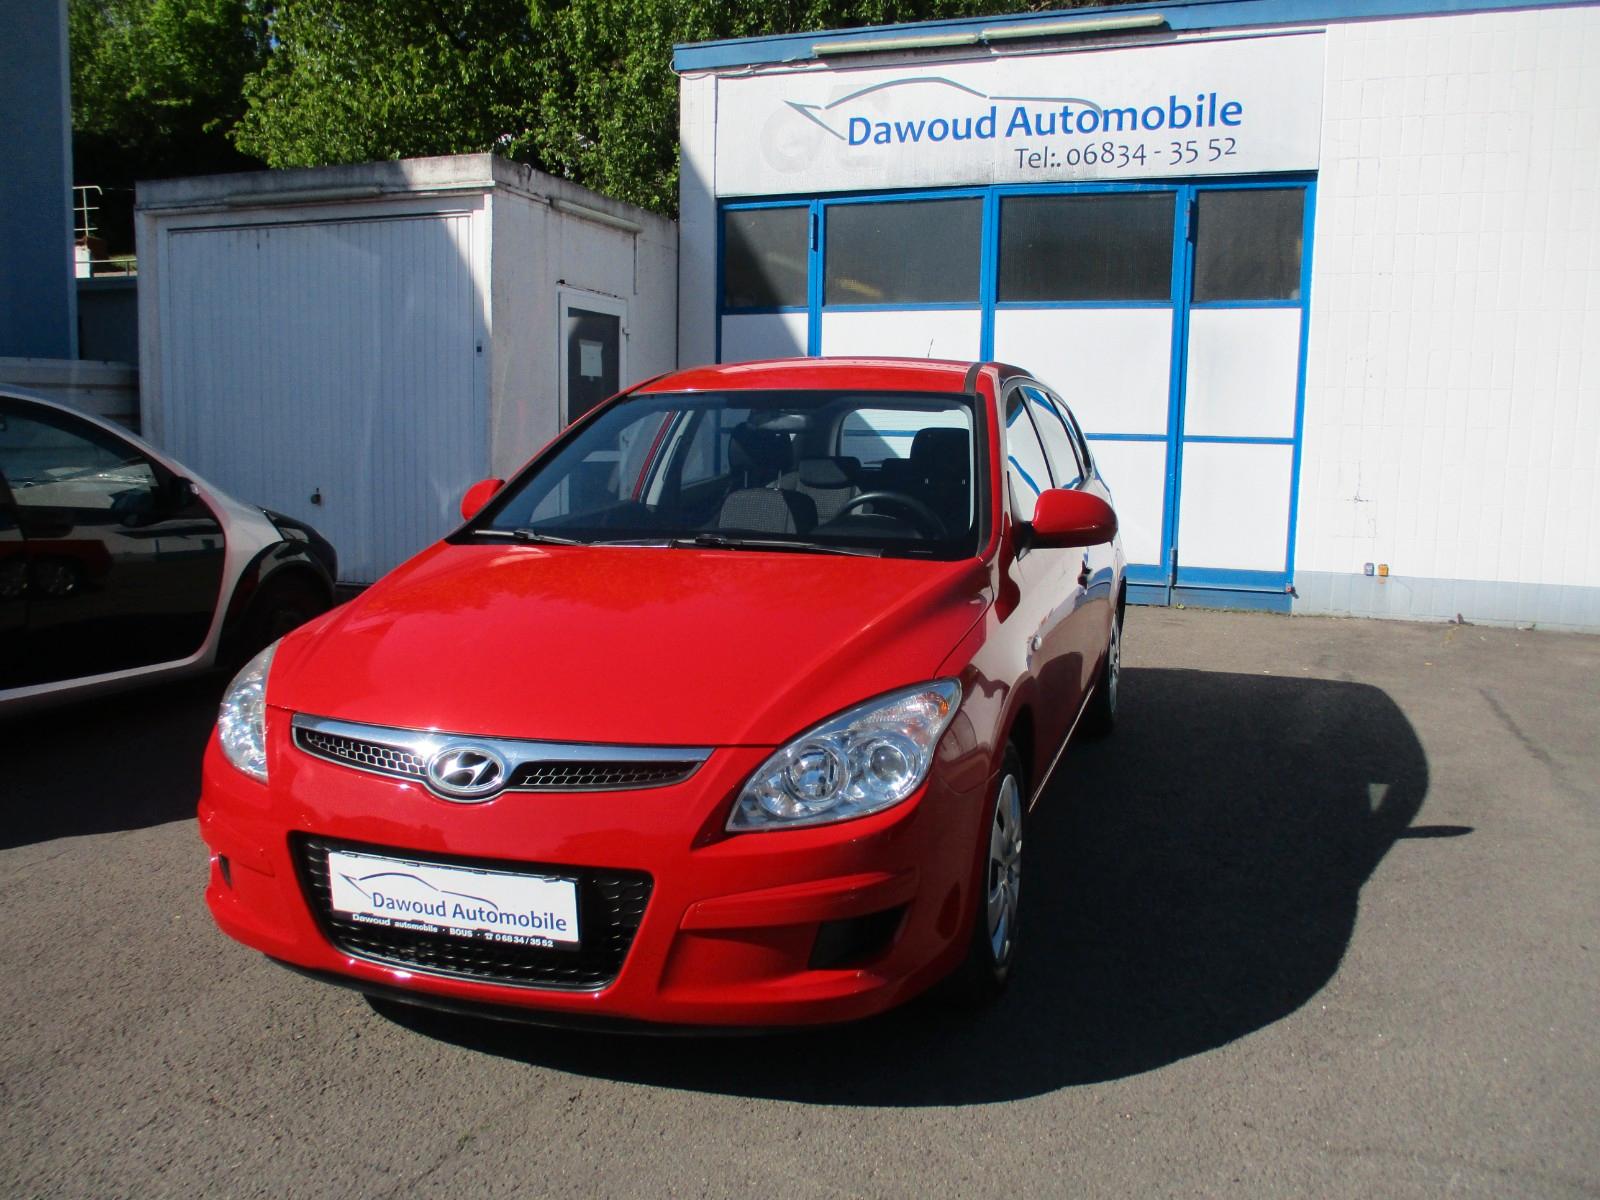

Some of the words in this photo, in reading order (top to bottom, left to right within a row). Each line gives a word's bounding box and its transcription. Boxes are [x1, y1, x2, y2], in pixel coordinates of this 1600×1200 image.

[848, 105, 997, 147] Dawoud
[1005, 92, 1243, 138] Automobile
[1066, 140, 1147, 169] 06834
[352, 913, 391, 926] Dawoud
[394, 920, 438, 933] automobile
[449, 927, 473, 938] BOUS
[372, 891, 447, 917] Dawoud
[452, 903, 567, 931] Automobile
